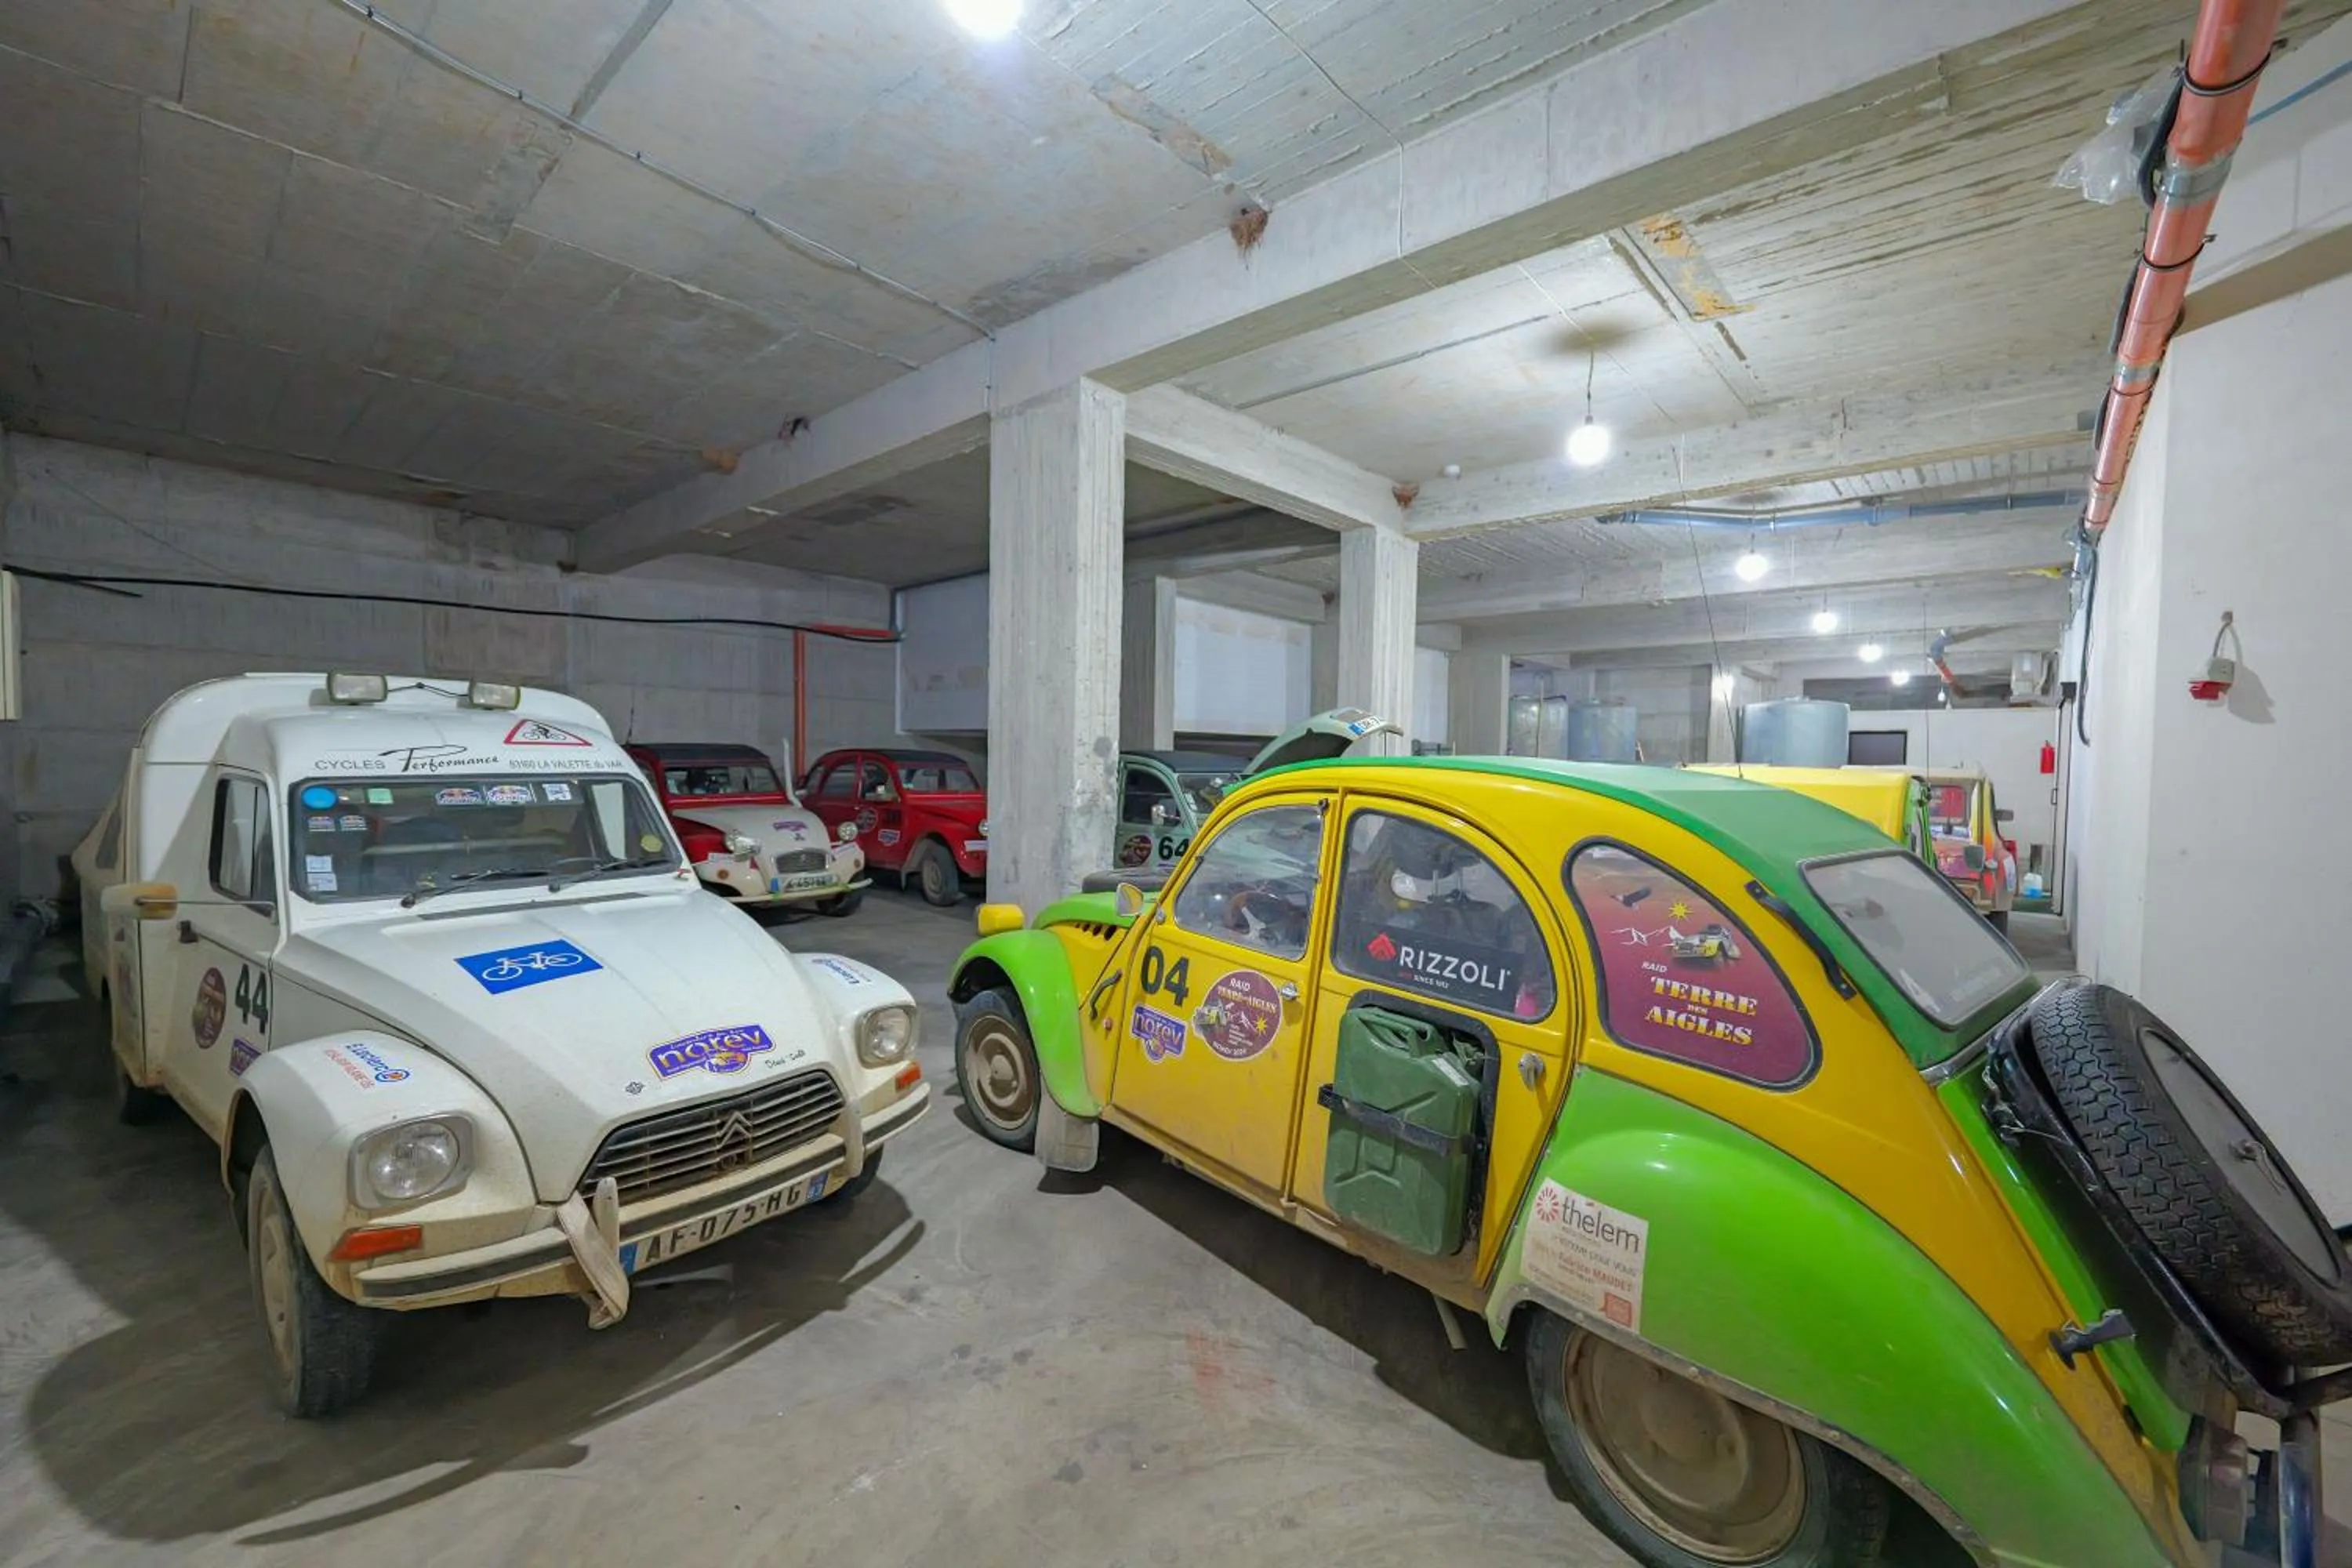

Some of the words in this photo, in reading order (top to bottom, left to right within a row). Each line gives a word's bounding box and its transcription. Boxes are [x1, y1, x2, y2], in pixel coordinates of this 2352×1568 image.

[314, 758, 387, 771] CYCLES
[378, 744, 500, 773] Performance
[1158, 836, 1189, 861] 64
[1141, 946, 1189, 1007] 04
[1229, 978, 1251, 992] RAID
[1399, 946, 1506, 991] RIZZOLI
[1641, 961, 1668, 973] RAID
[234, 963, 269, 1036] 44
[1650, 976, 1759, 1017] TERRE
[1136, 1014, 1182, 1046] norev
[1644, 1005, 1754, 1046] AIGLES
[656, 1029, 762, 1069] norev
